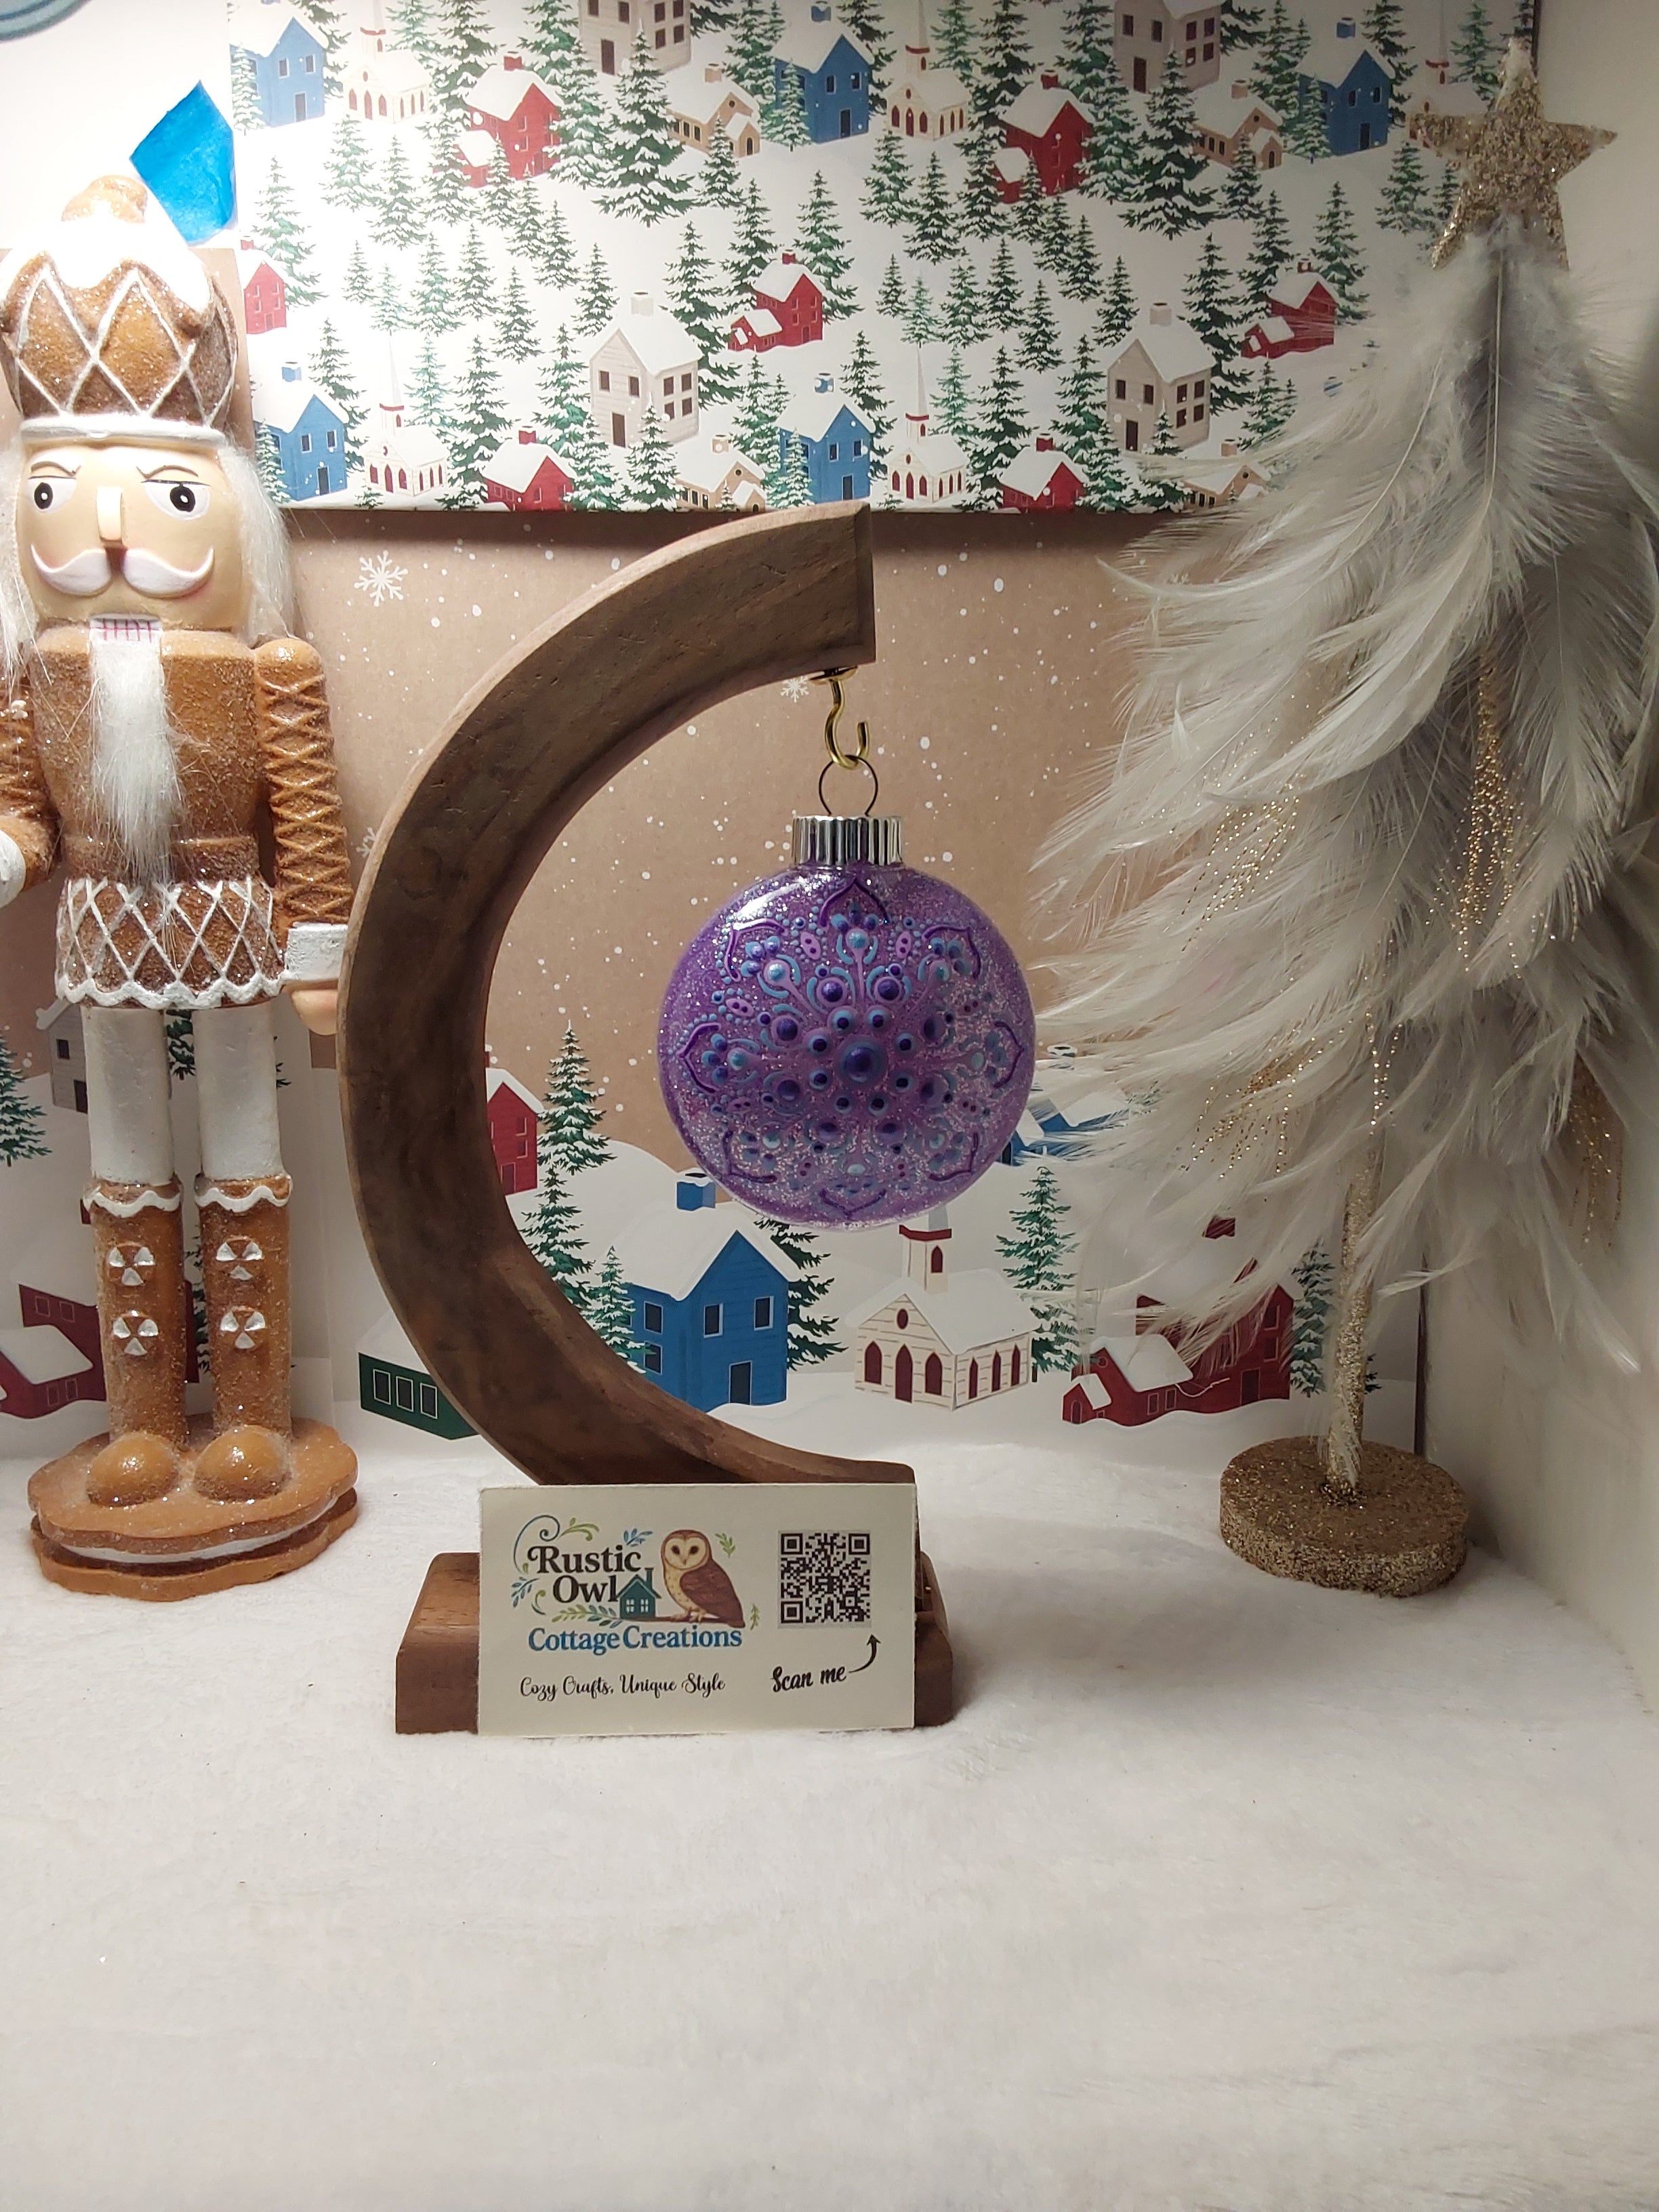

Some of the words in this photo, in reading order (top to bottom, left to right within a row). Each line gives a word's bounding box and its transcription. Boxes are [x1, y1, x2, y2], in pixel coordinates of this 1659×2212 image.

[527, 1544, 641, 1574] Rustic
[552, 1574, 619, 1605] Owl
[528, 1625, 621, 1656] Cottage
[623, 1625, 743, 1650] Creations
[520, 1676, 558, 1702] Cozy
[562, 1675, 615, 1700] Crafts,
[619, 1674, 677, 1699] Unique
[680, 1673, 726, 1698] Style
[770, 1666, 814, 1693] Scan
[820, 1666, 847, 1683] me
